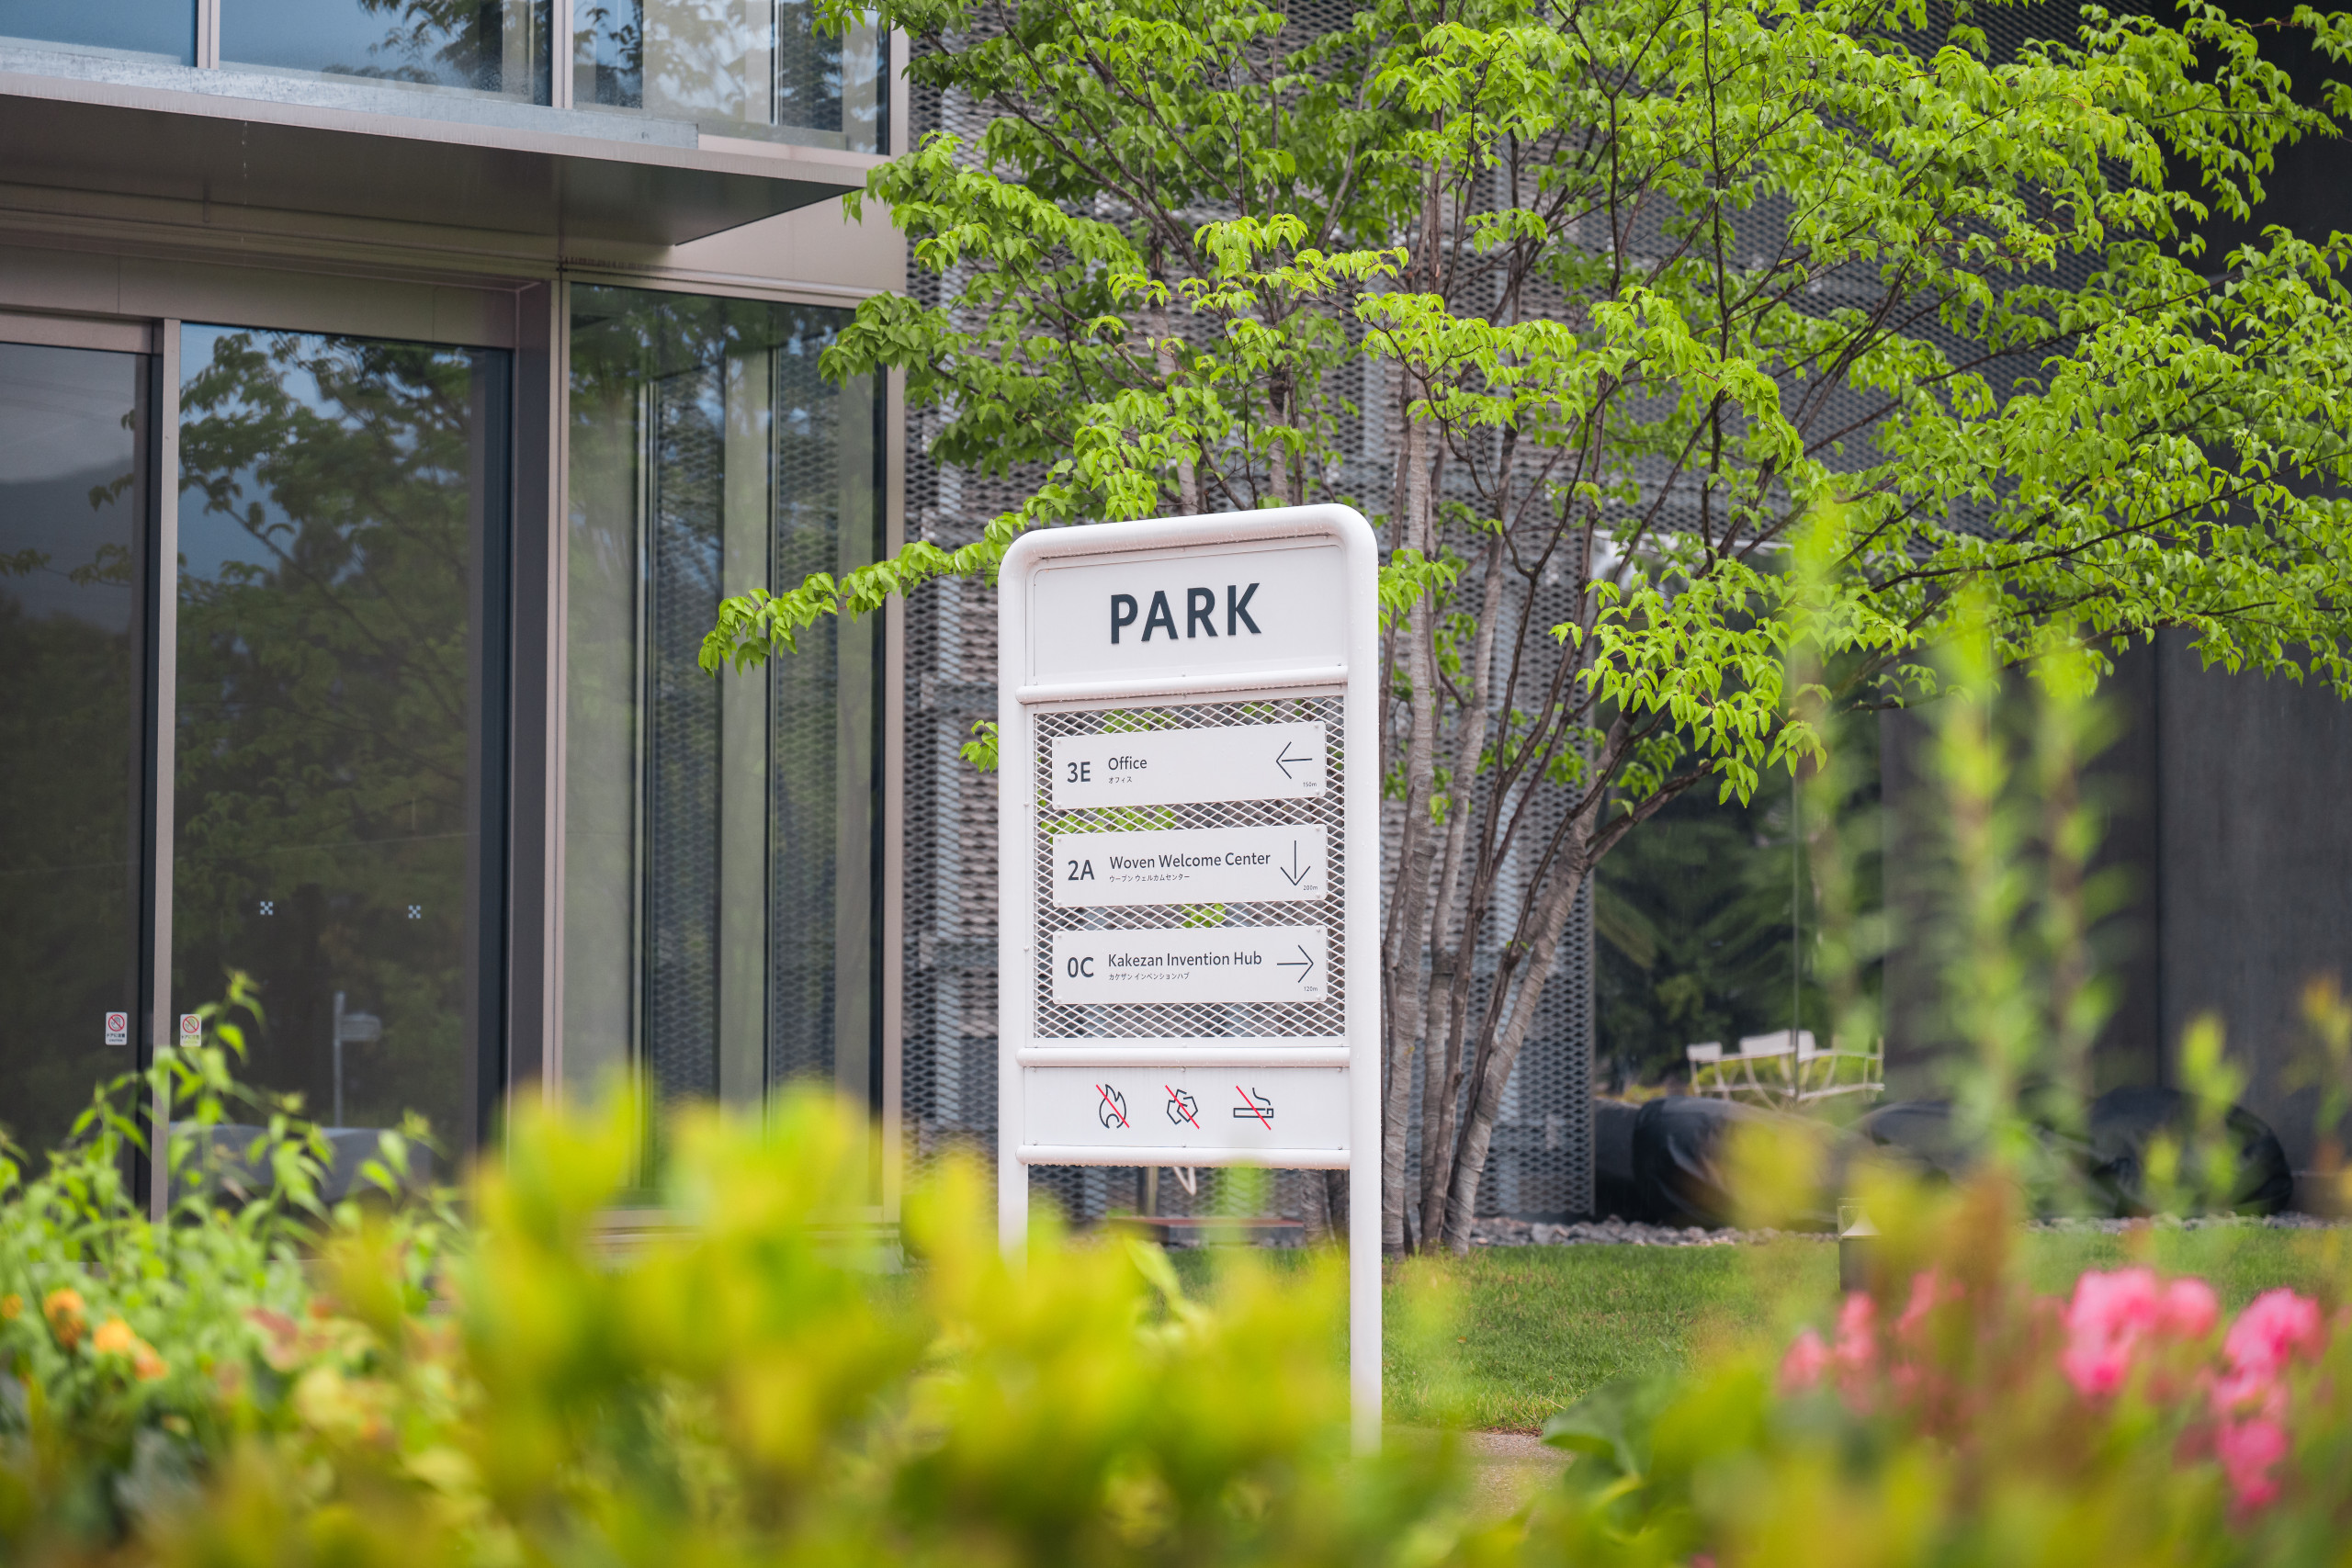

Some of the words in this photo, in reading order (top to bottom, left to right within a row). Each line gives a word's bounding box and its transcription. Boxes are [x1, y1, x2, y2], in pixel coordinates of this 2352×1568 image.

[1111, 582, 1262, 645] PARK
[1067, 761, 1091, 784] 3E
[1108, 756, 1148, 771] Office
[1108, 775, 1133, 784] オフィス
[1109, 855, 1156, 870] Woven
[1158, 853, 1222, 868] Welcome
[1225, 852, 1272, 866] Center
[1067, 859, 1095, 882] 2A
[1108, 953, 1163, 967] Kakezan
[1167, 951, 1230, 966] Invention
[1234, 950, 1262, 965] Hub
